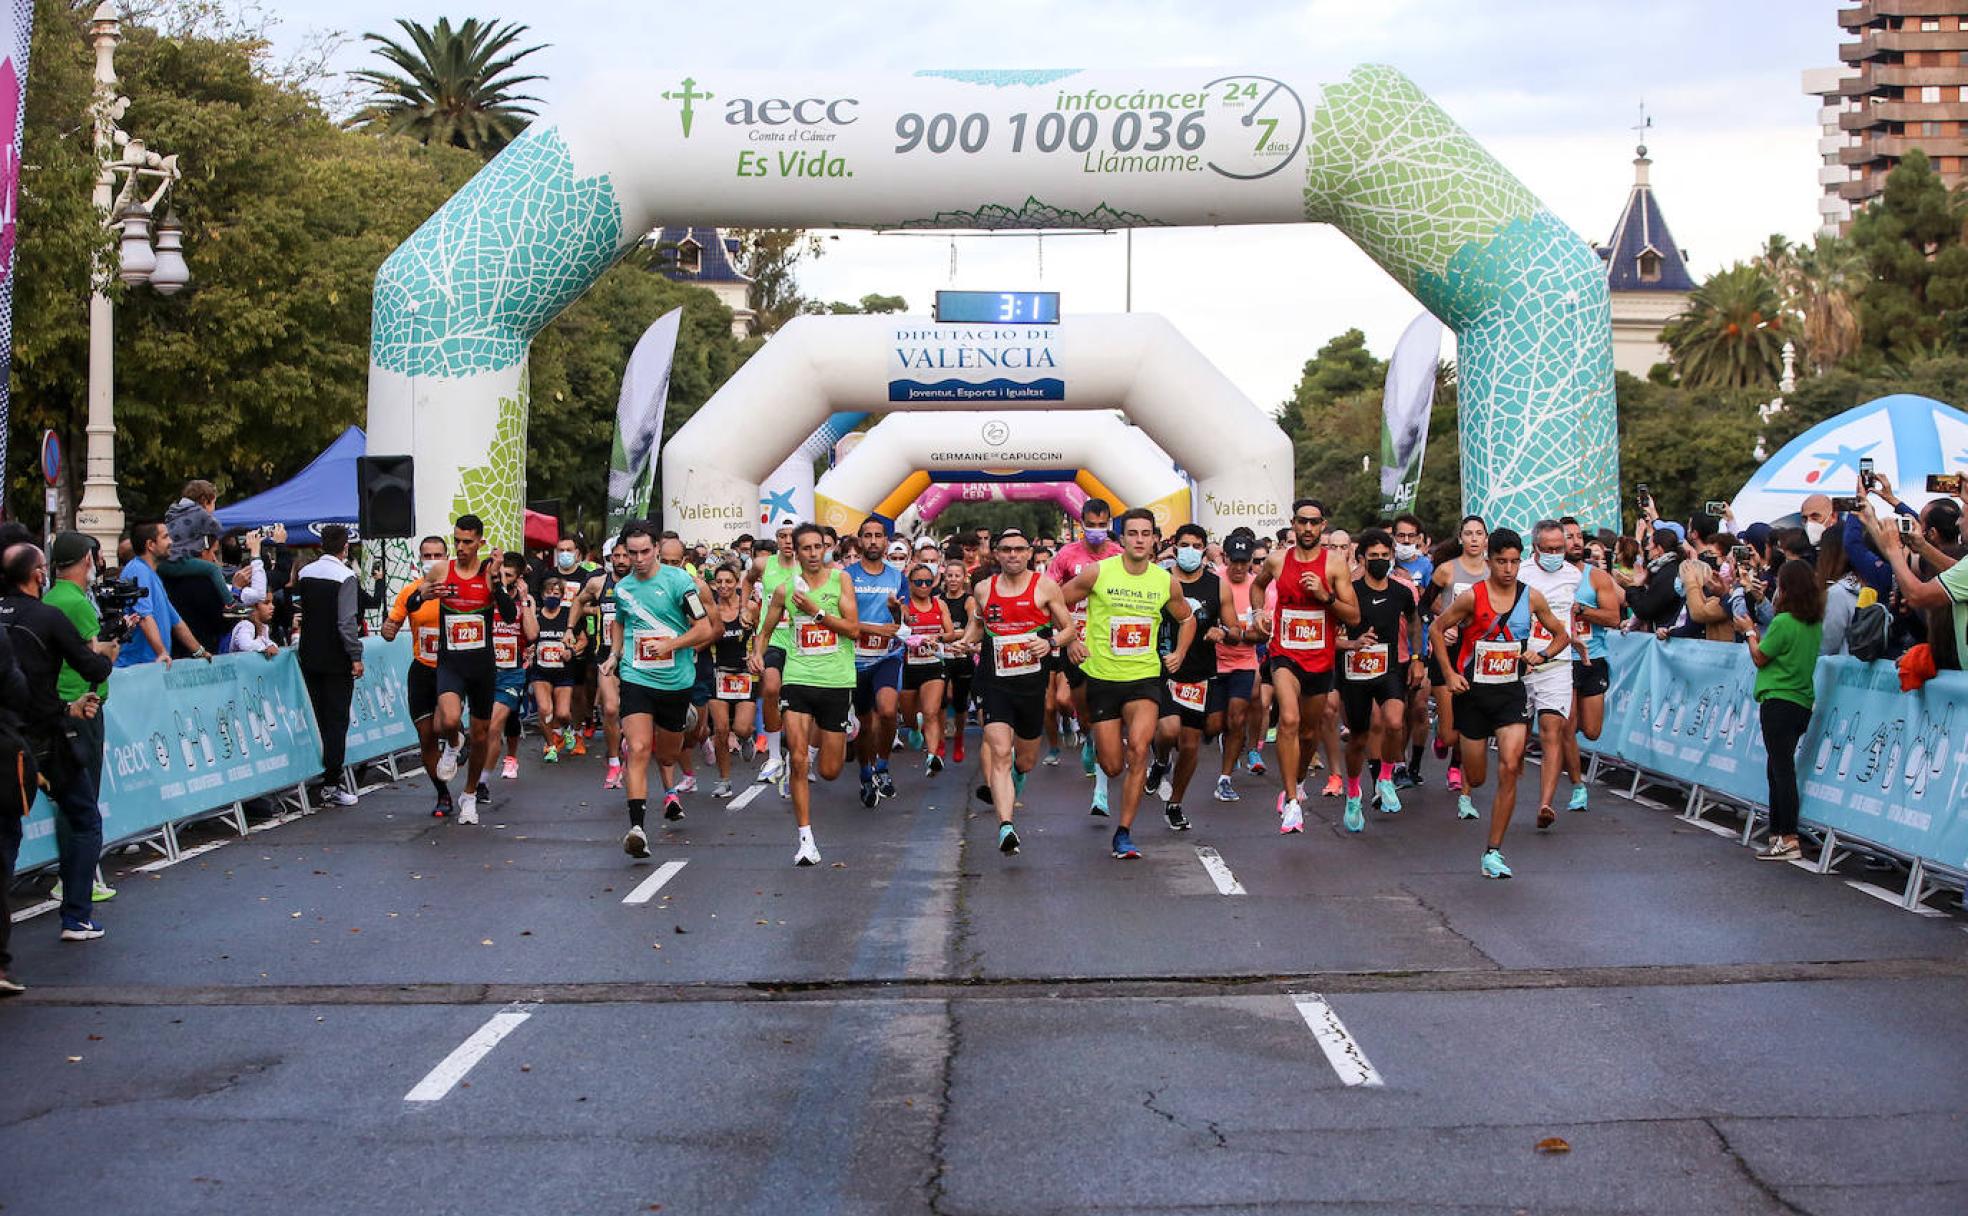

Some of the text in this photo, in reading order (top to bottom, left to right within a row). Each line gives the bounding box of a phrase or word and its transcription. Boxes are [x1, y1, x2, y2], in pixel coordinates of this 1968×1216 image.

[1223, 82, 1258, 100] 24
[1055, 90, 1209, 111] infocáncer
[725, 98, 859, 125] aecc
[748, 129, 837, 141] Contra el Cáncer
[894, 110, 1206, 153] 900 100 036
[1255, 119, 1279, 151] 7
[737, 149, 853, 177] Es Vida.
[1083, 150, 1203, 173] Llámame.
[1027, 330, 1054, 340] DE
[896, 344, 1057, 369] VALÈNCIA
[957, 387, 996, 399] Esports
[1006, 387, 1044, 399] Igualtat
[930, 452, 991, 461] GERMAINE
[1000, 452, 1063, 461] CAPUCCINI
[679, 503, 744, 520] València
[1213, 500, 1278, 516] València
[807, 629, 830, 645] 1757
